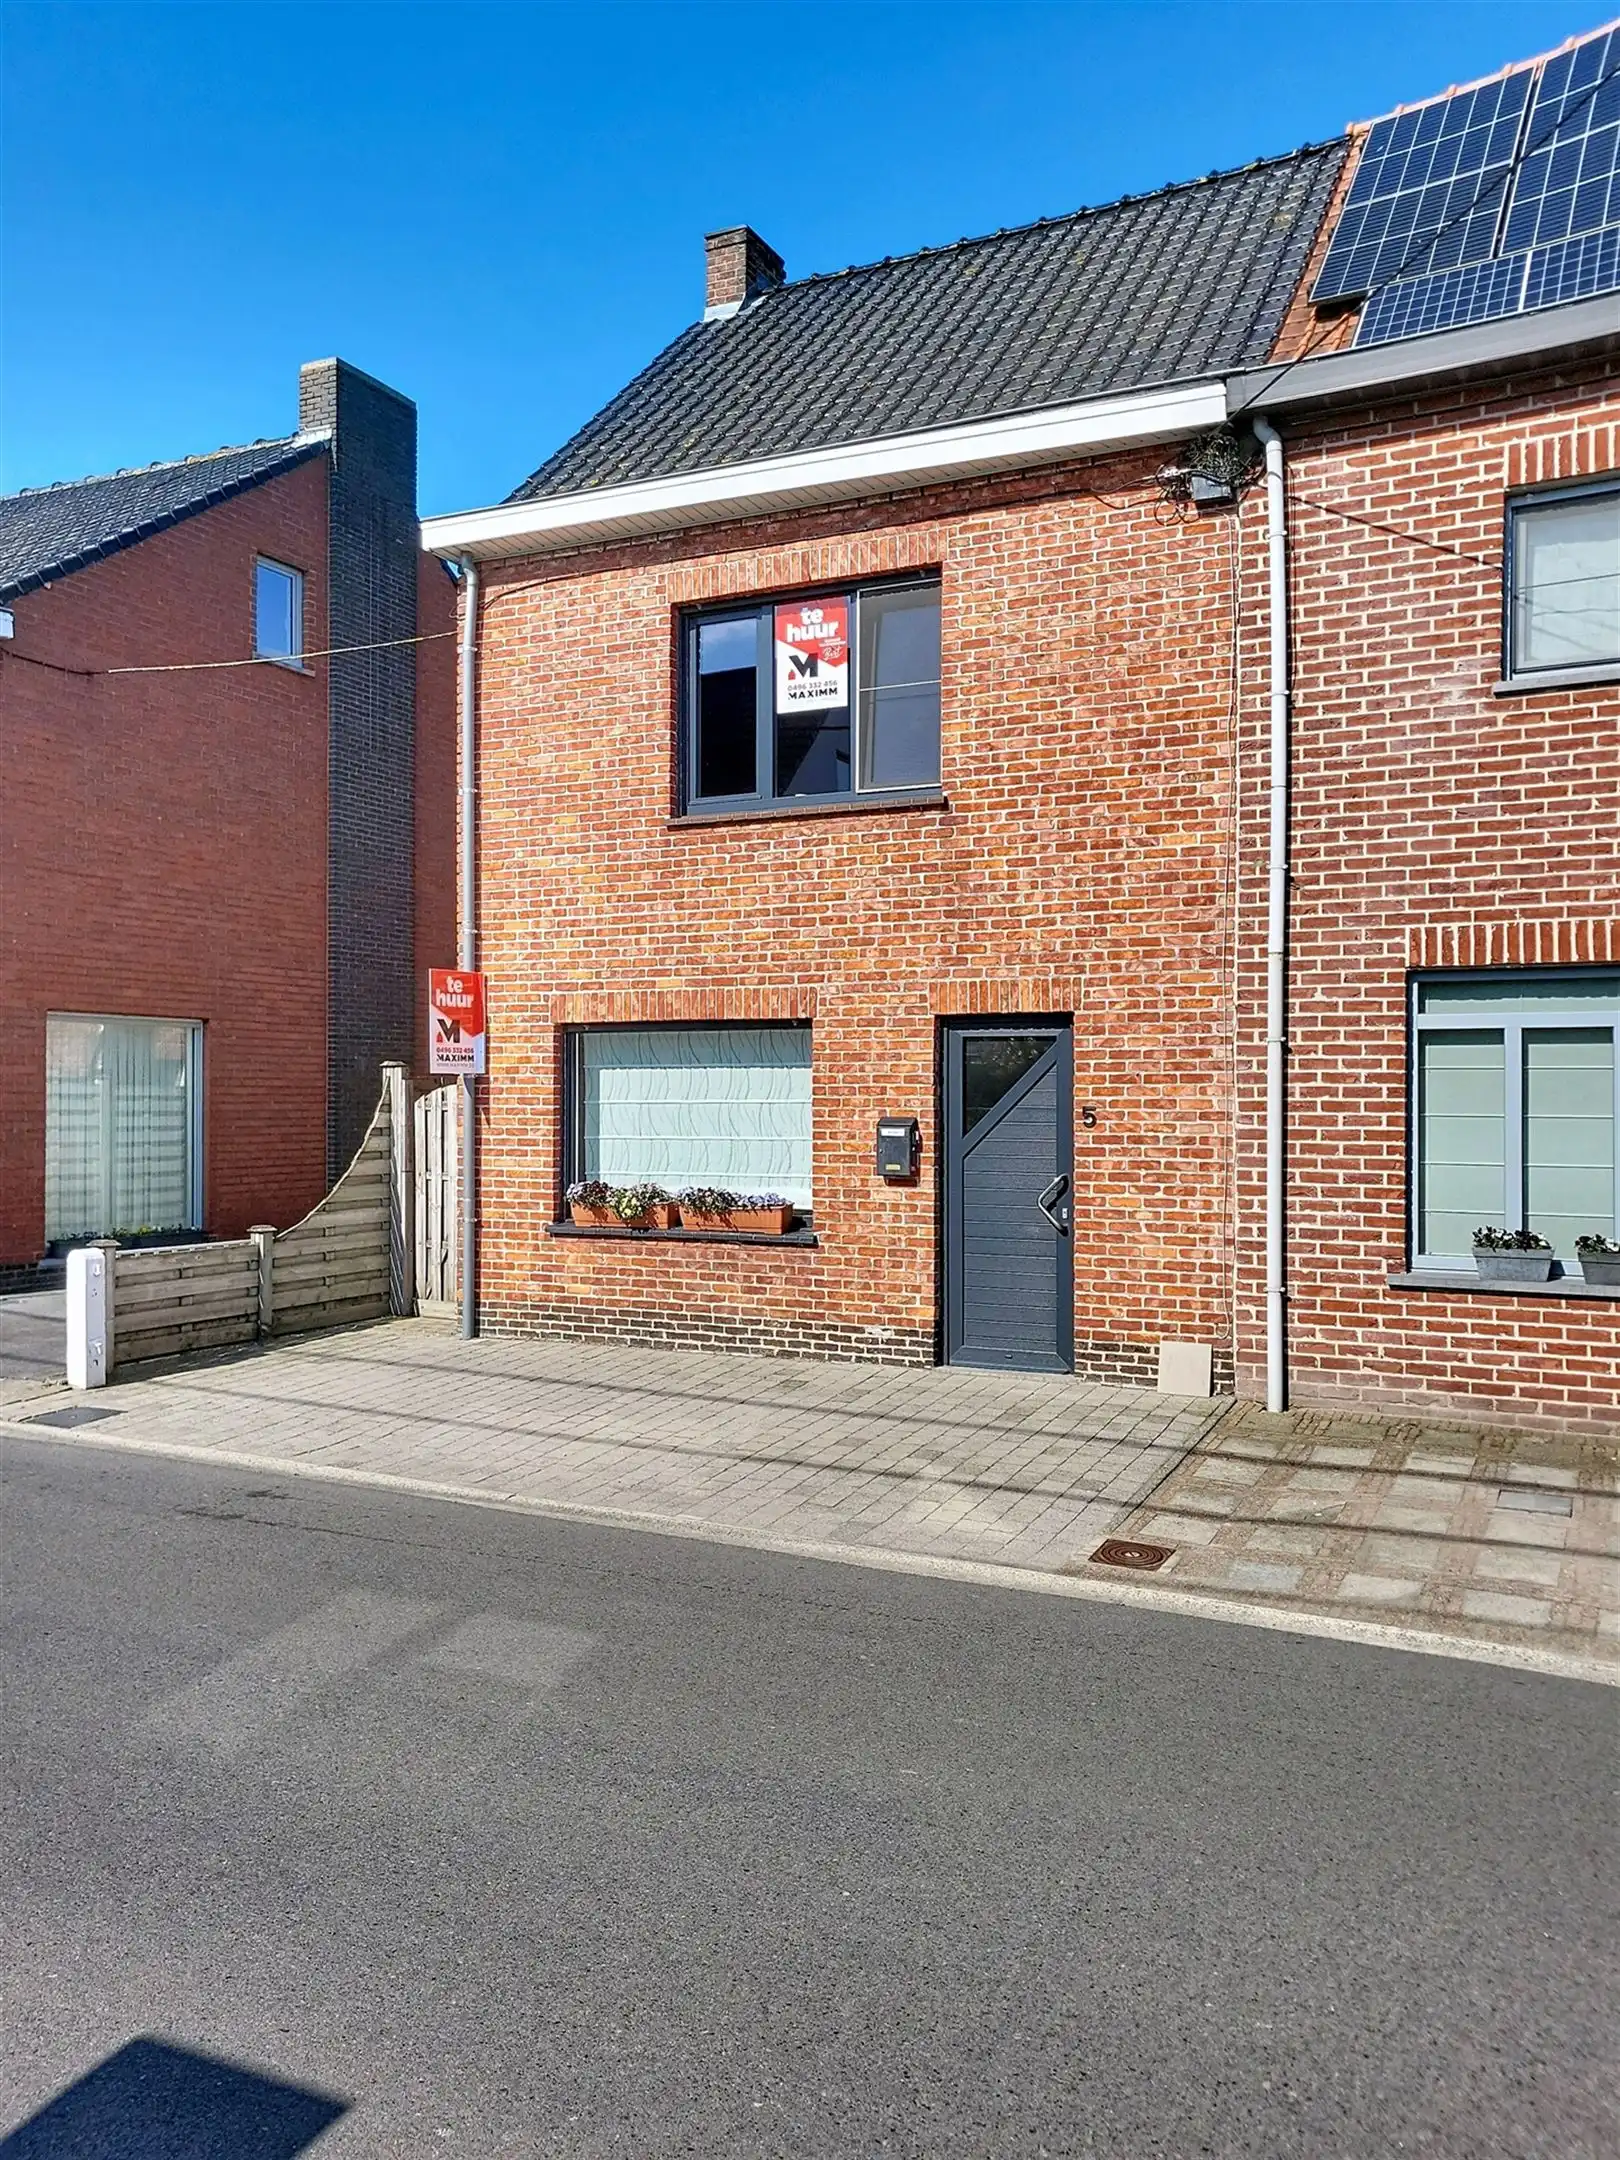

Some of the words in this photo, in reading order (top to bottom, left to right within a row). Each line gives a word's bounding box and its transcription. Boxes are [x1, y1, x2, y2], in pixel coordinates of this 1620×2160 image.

[801, 607, 824, 625] te
[786, 621, 839, 642] huur
[788, 687, 838, 700] MAXIMM
[446, 975, 463, 993] te
[435, 989, 475, 1008] huur
[436, 1054, 475, 1062] MAXIMM
[1081, 1105, 1098, 1129] 5
